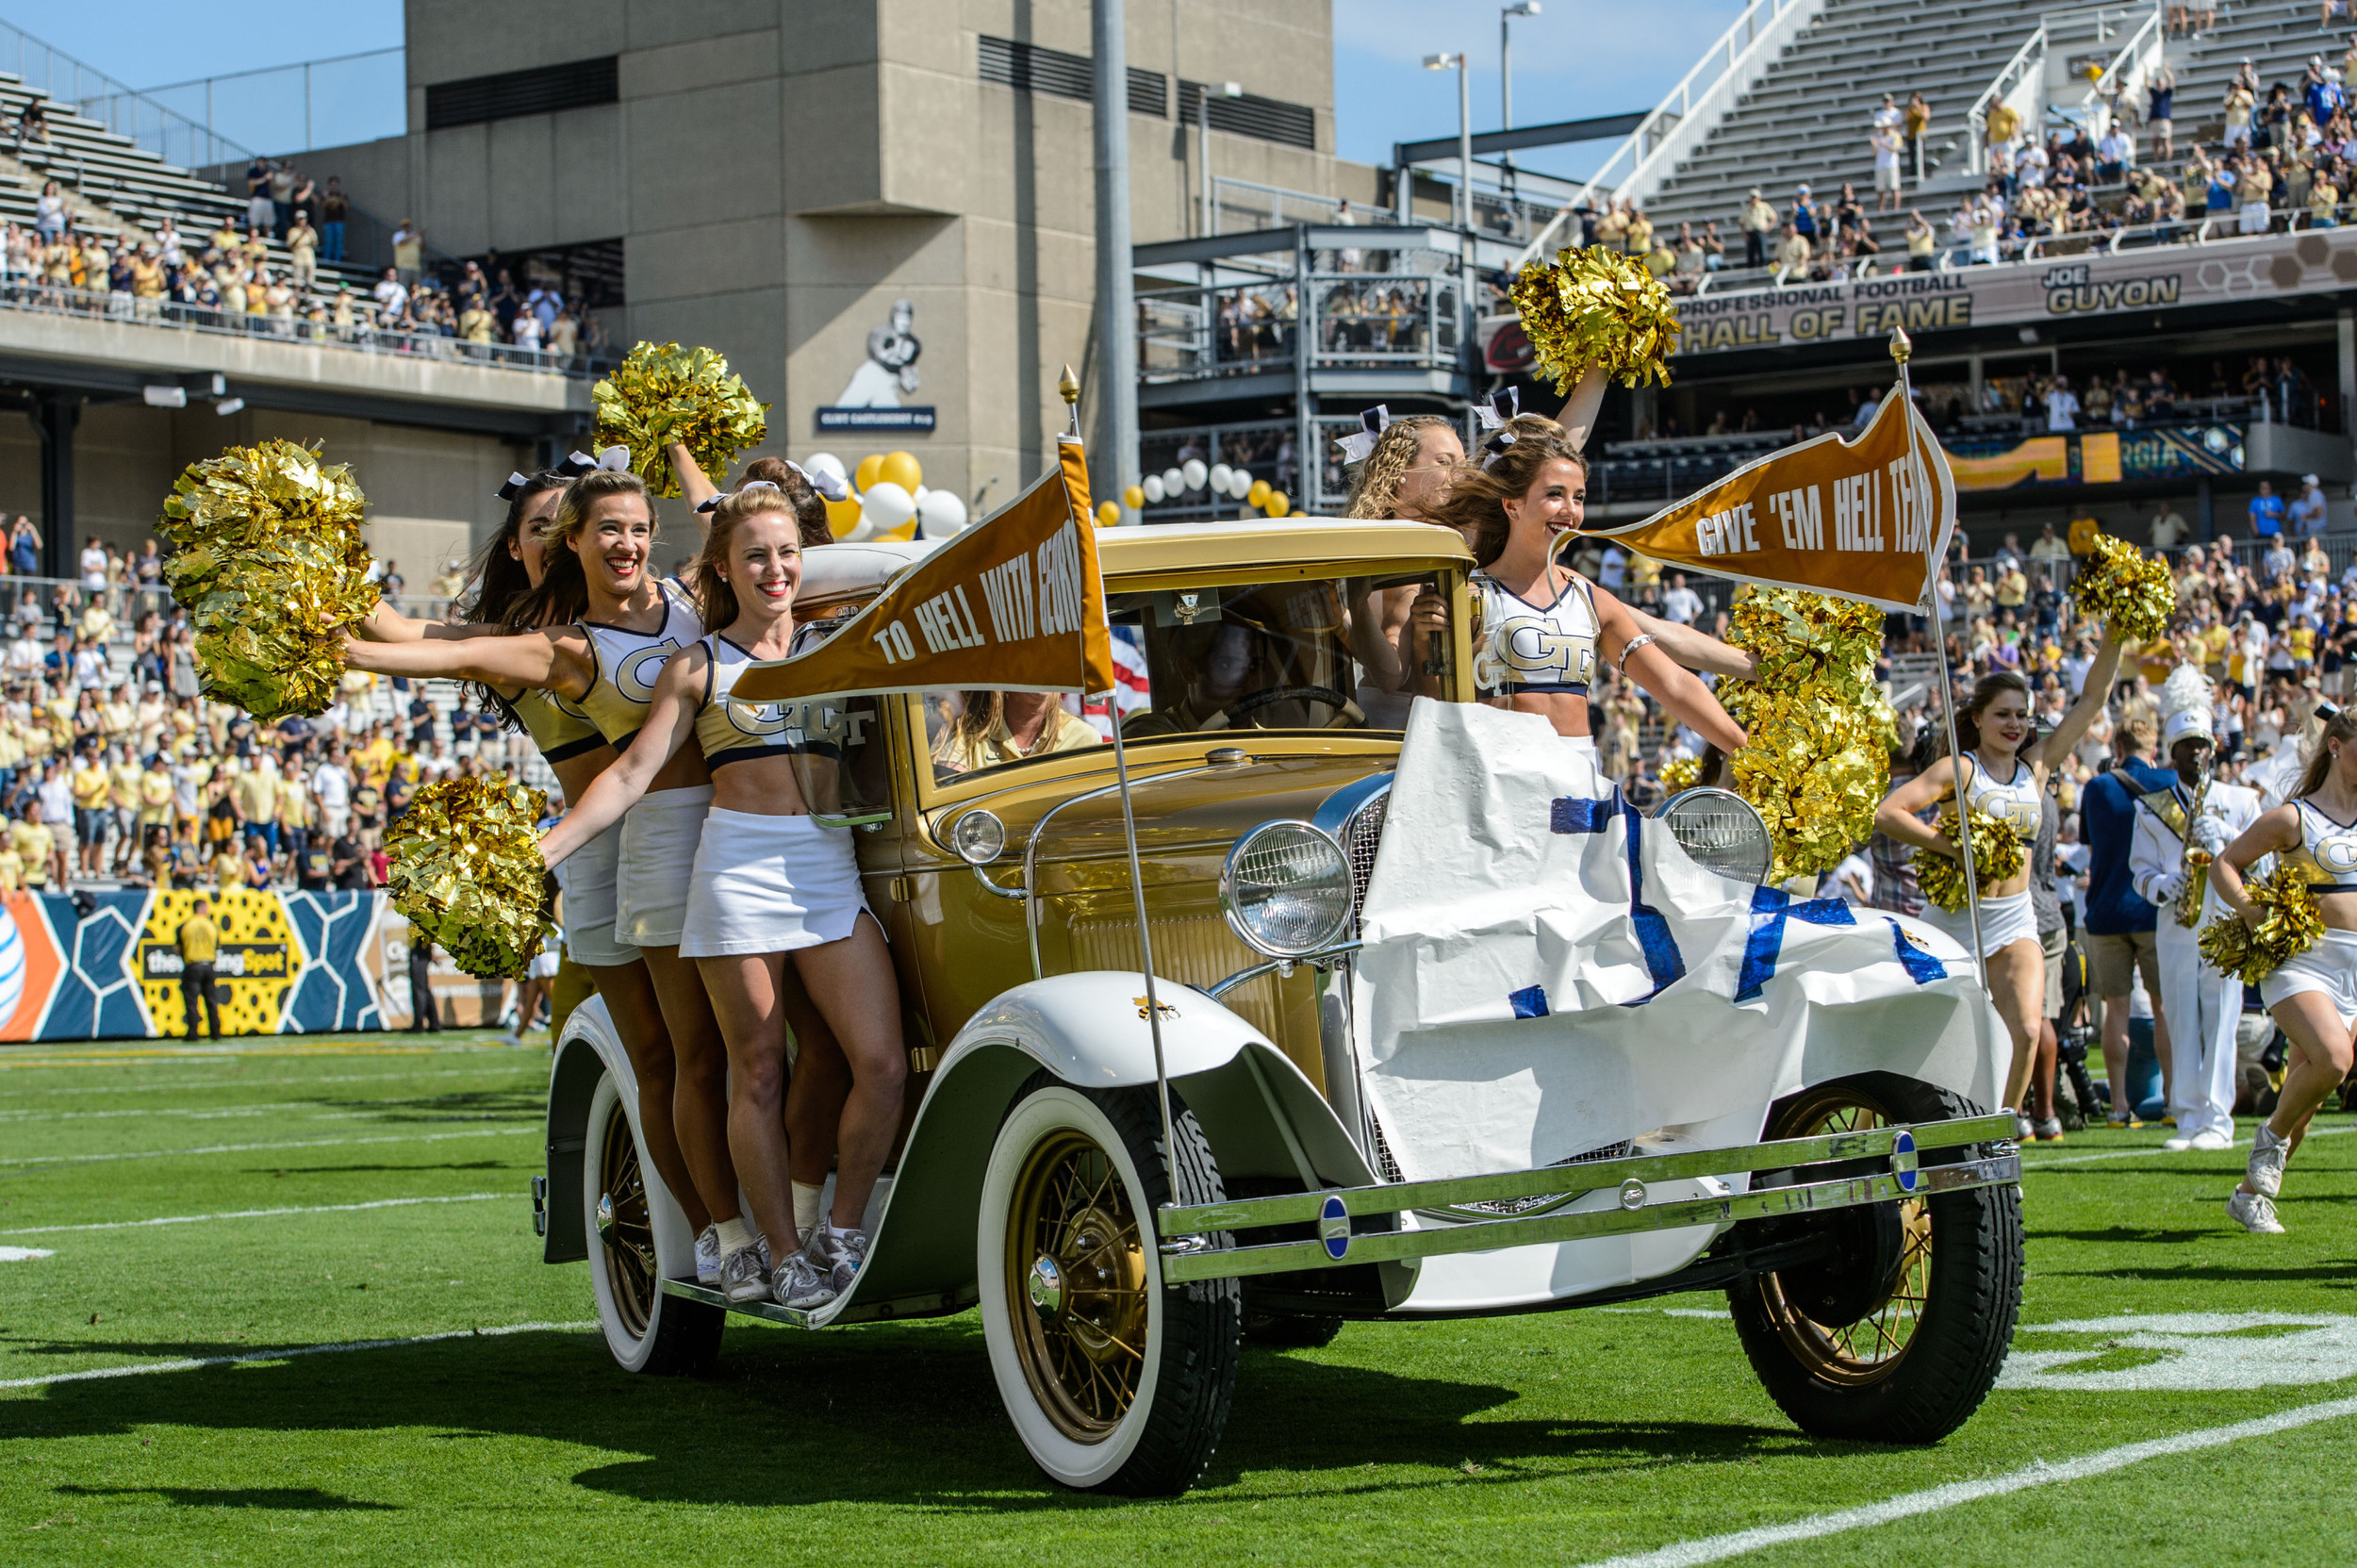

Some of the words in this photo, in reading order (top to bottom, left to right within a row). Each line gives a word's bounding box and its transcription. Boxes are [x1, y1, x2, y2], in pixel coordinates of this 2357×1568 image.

[1677, 288, 1844, 318] PROFESSIONAL
[1854, 273, 1967, 299] FOOTBALL
[2042, 265, 2089, 289] JOE
[2047, 274, 2181, 314] GUYON
[1682, 313, 1780, 352] HALL
[1791, 305, 1845, 339] OF
[1854, 292, 1972, 335] FAME
[1695, 501, 1761, 557] GIVE
[1769, 483, 1824, 551] 'EM
[1833, 469, 1885, 553] HELL
[873, 619, 915, 665] TO
[914, 584, 986, 653] HELL
[979, 551, 1035, 643] WITH
[1474, 652, 1506, 697] GT
